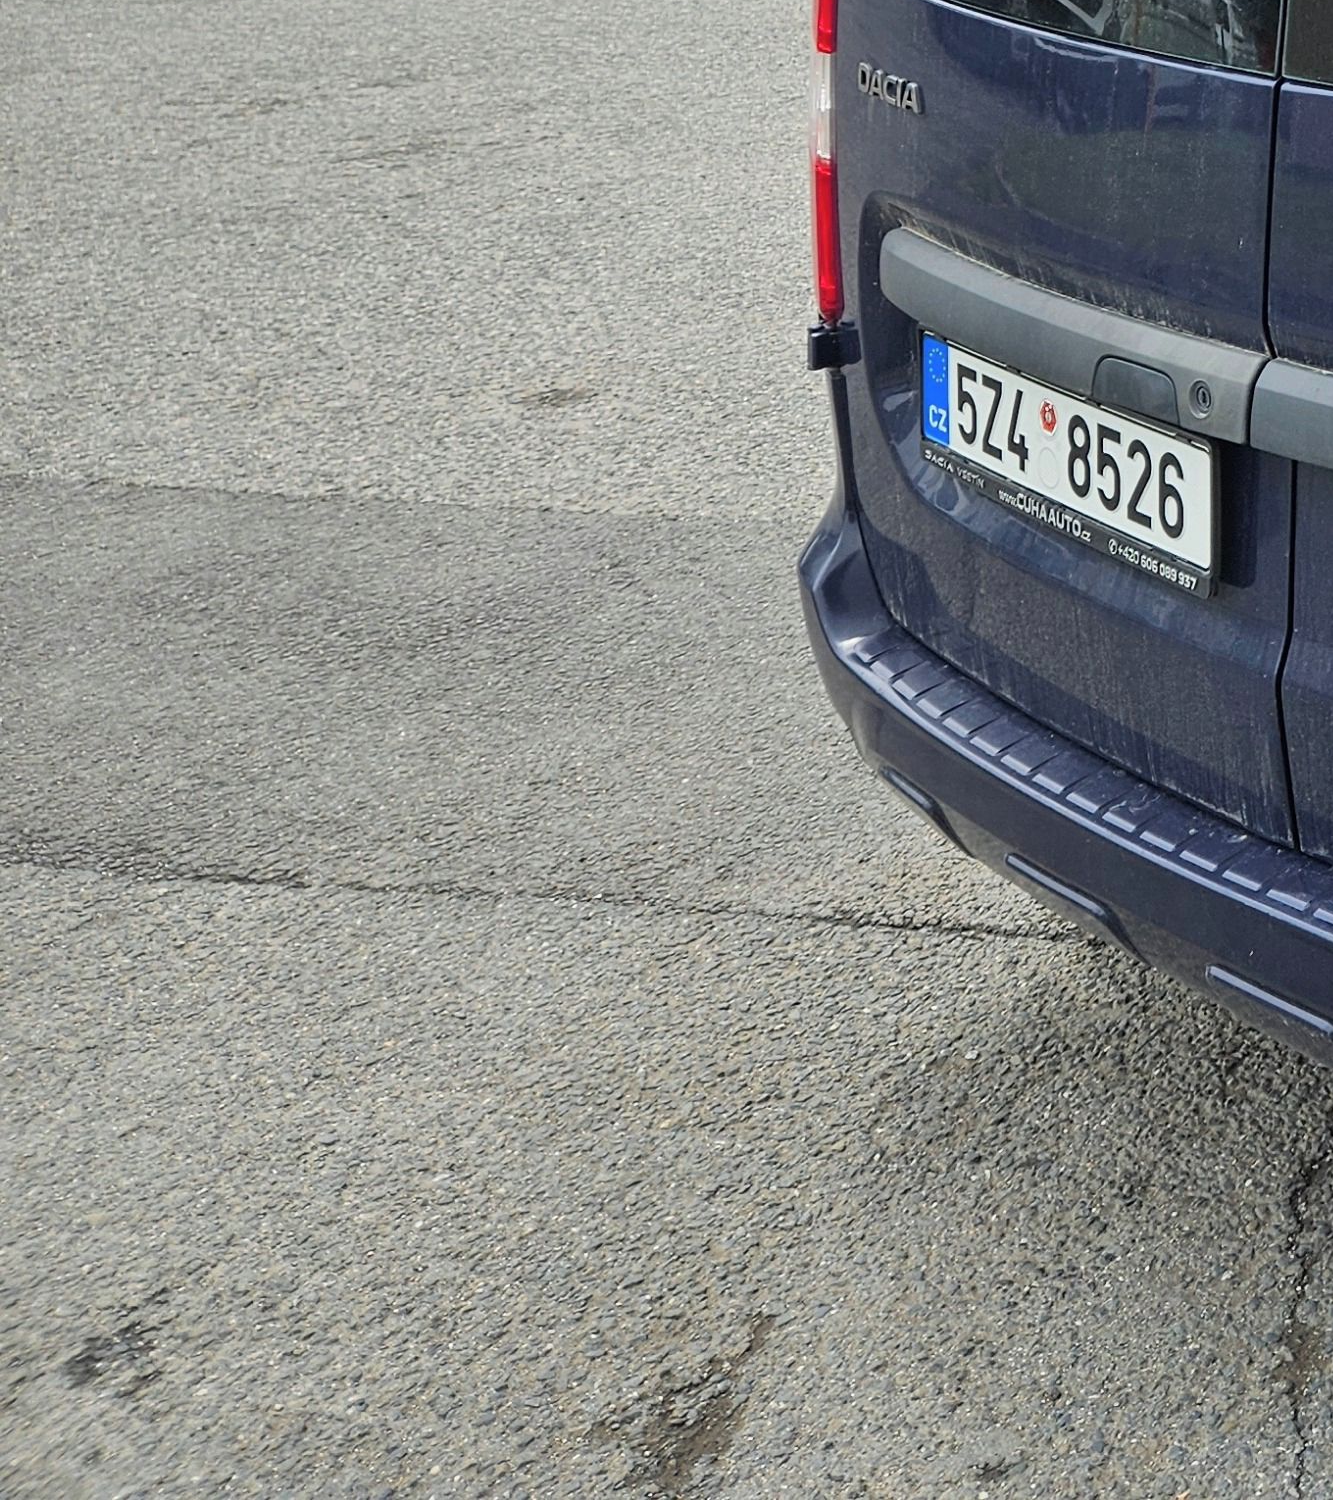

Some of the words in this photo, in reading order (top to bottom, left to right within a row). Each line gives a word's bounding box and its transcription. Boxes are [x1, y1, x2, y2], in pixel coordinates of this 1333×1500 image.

[858, 62, 922, 114] DACIA
[928, 404, 947, 433] CZ
[957, 363, 1029, 474] 5Z4
[1067, 414, 1185, 540] 8526
[1140, 555, 1159, 574] 606
[1178, 572, 1198, 591] 937
